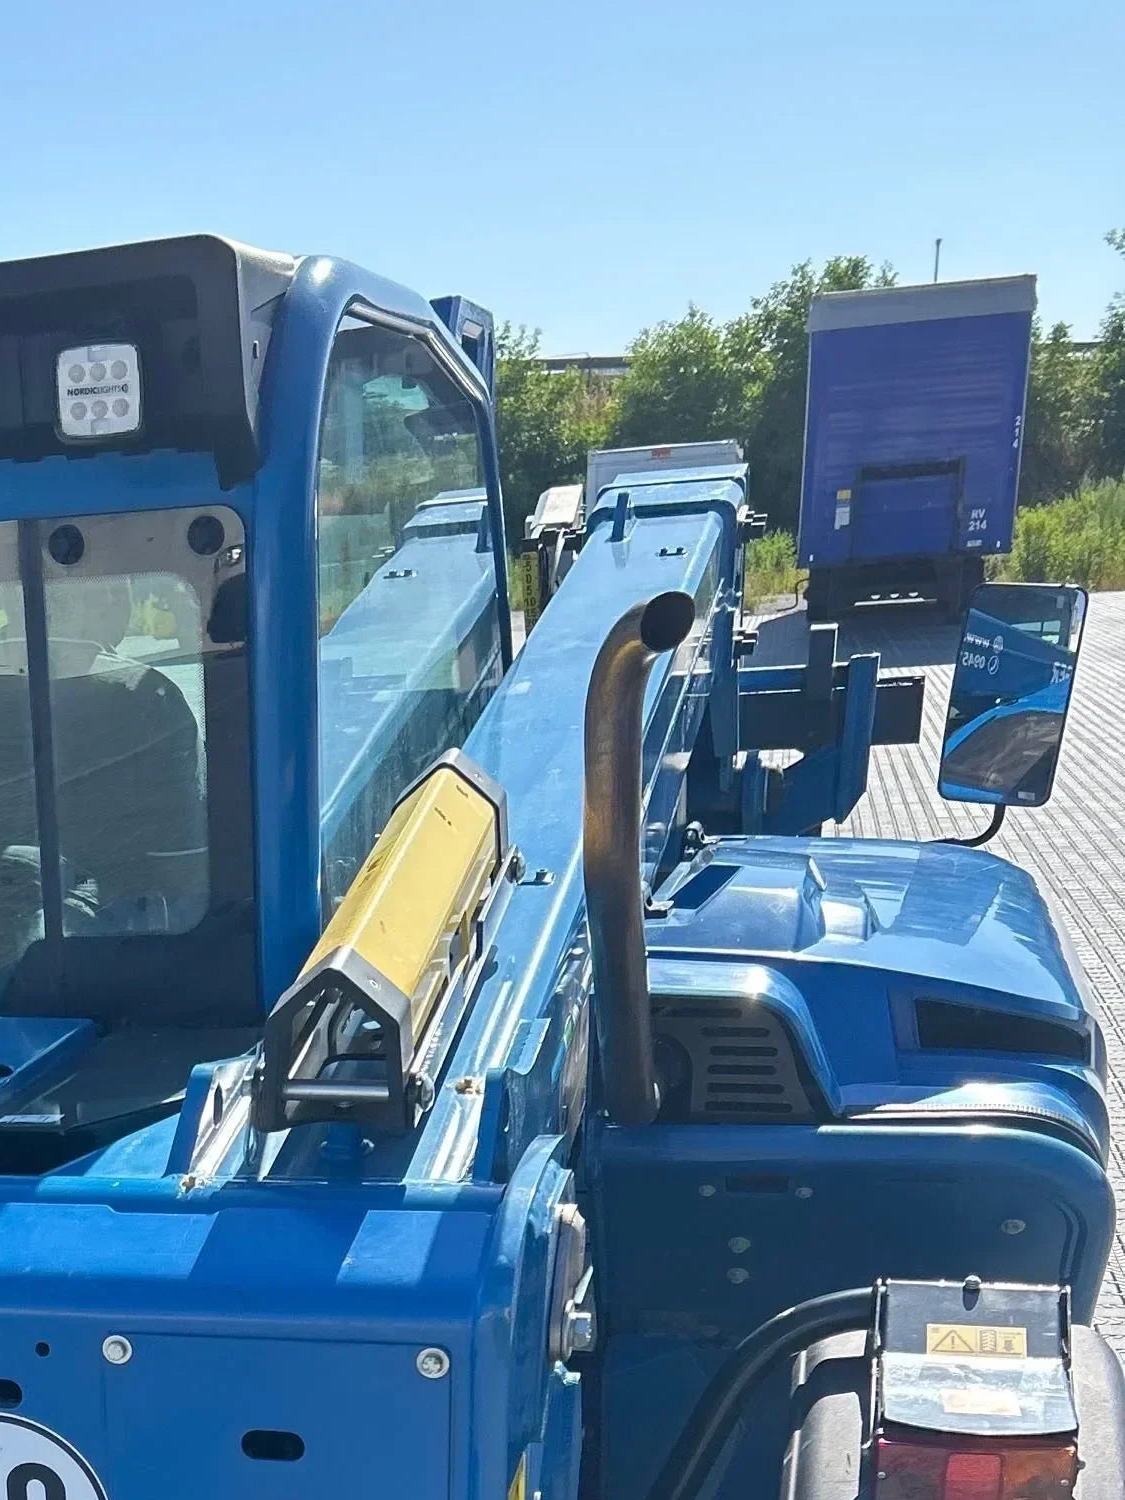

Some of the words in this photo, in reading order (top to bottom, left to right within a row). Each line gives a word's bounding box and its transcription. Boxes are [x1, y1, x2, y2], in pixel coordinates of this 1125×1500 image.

[1012, 415, 1022, 449] 214
[970, 508, 986, 519] RV
[968, 519, 987, 531] 214
